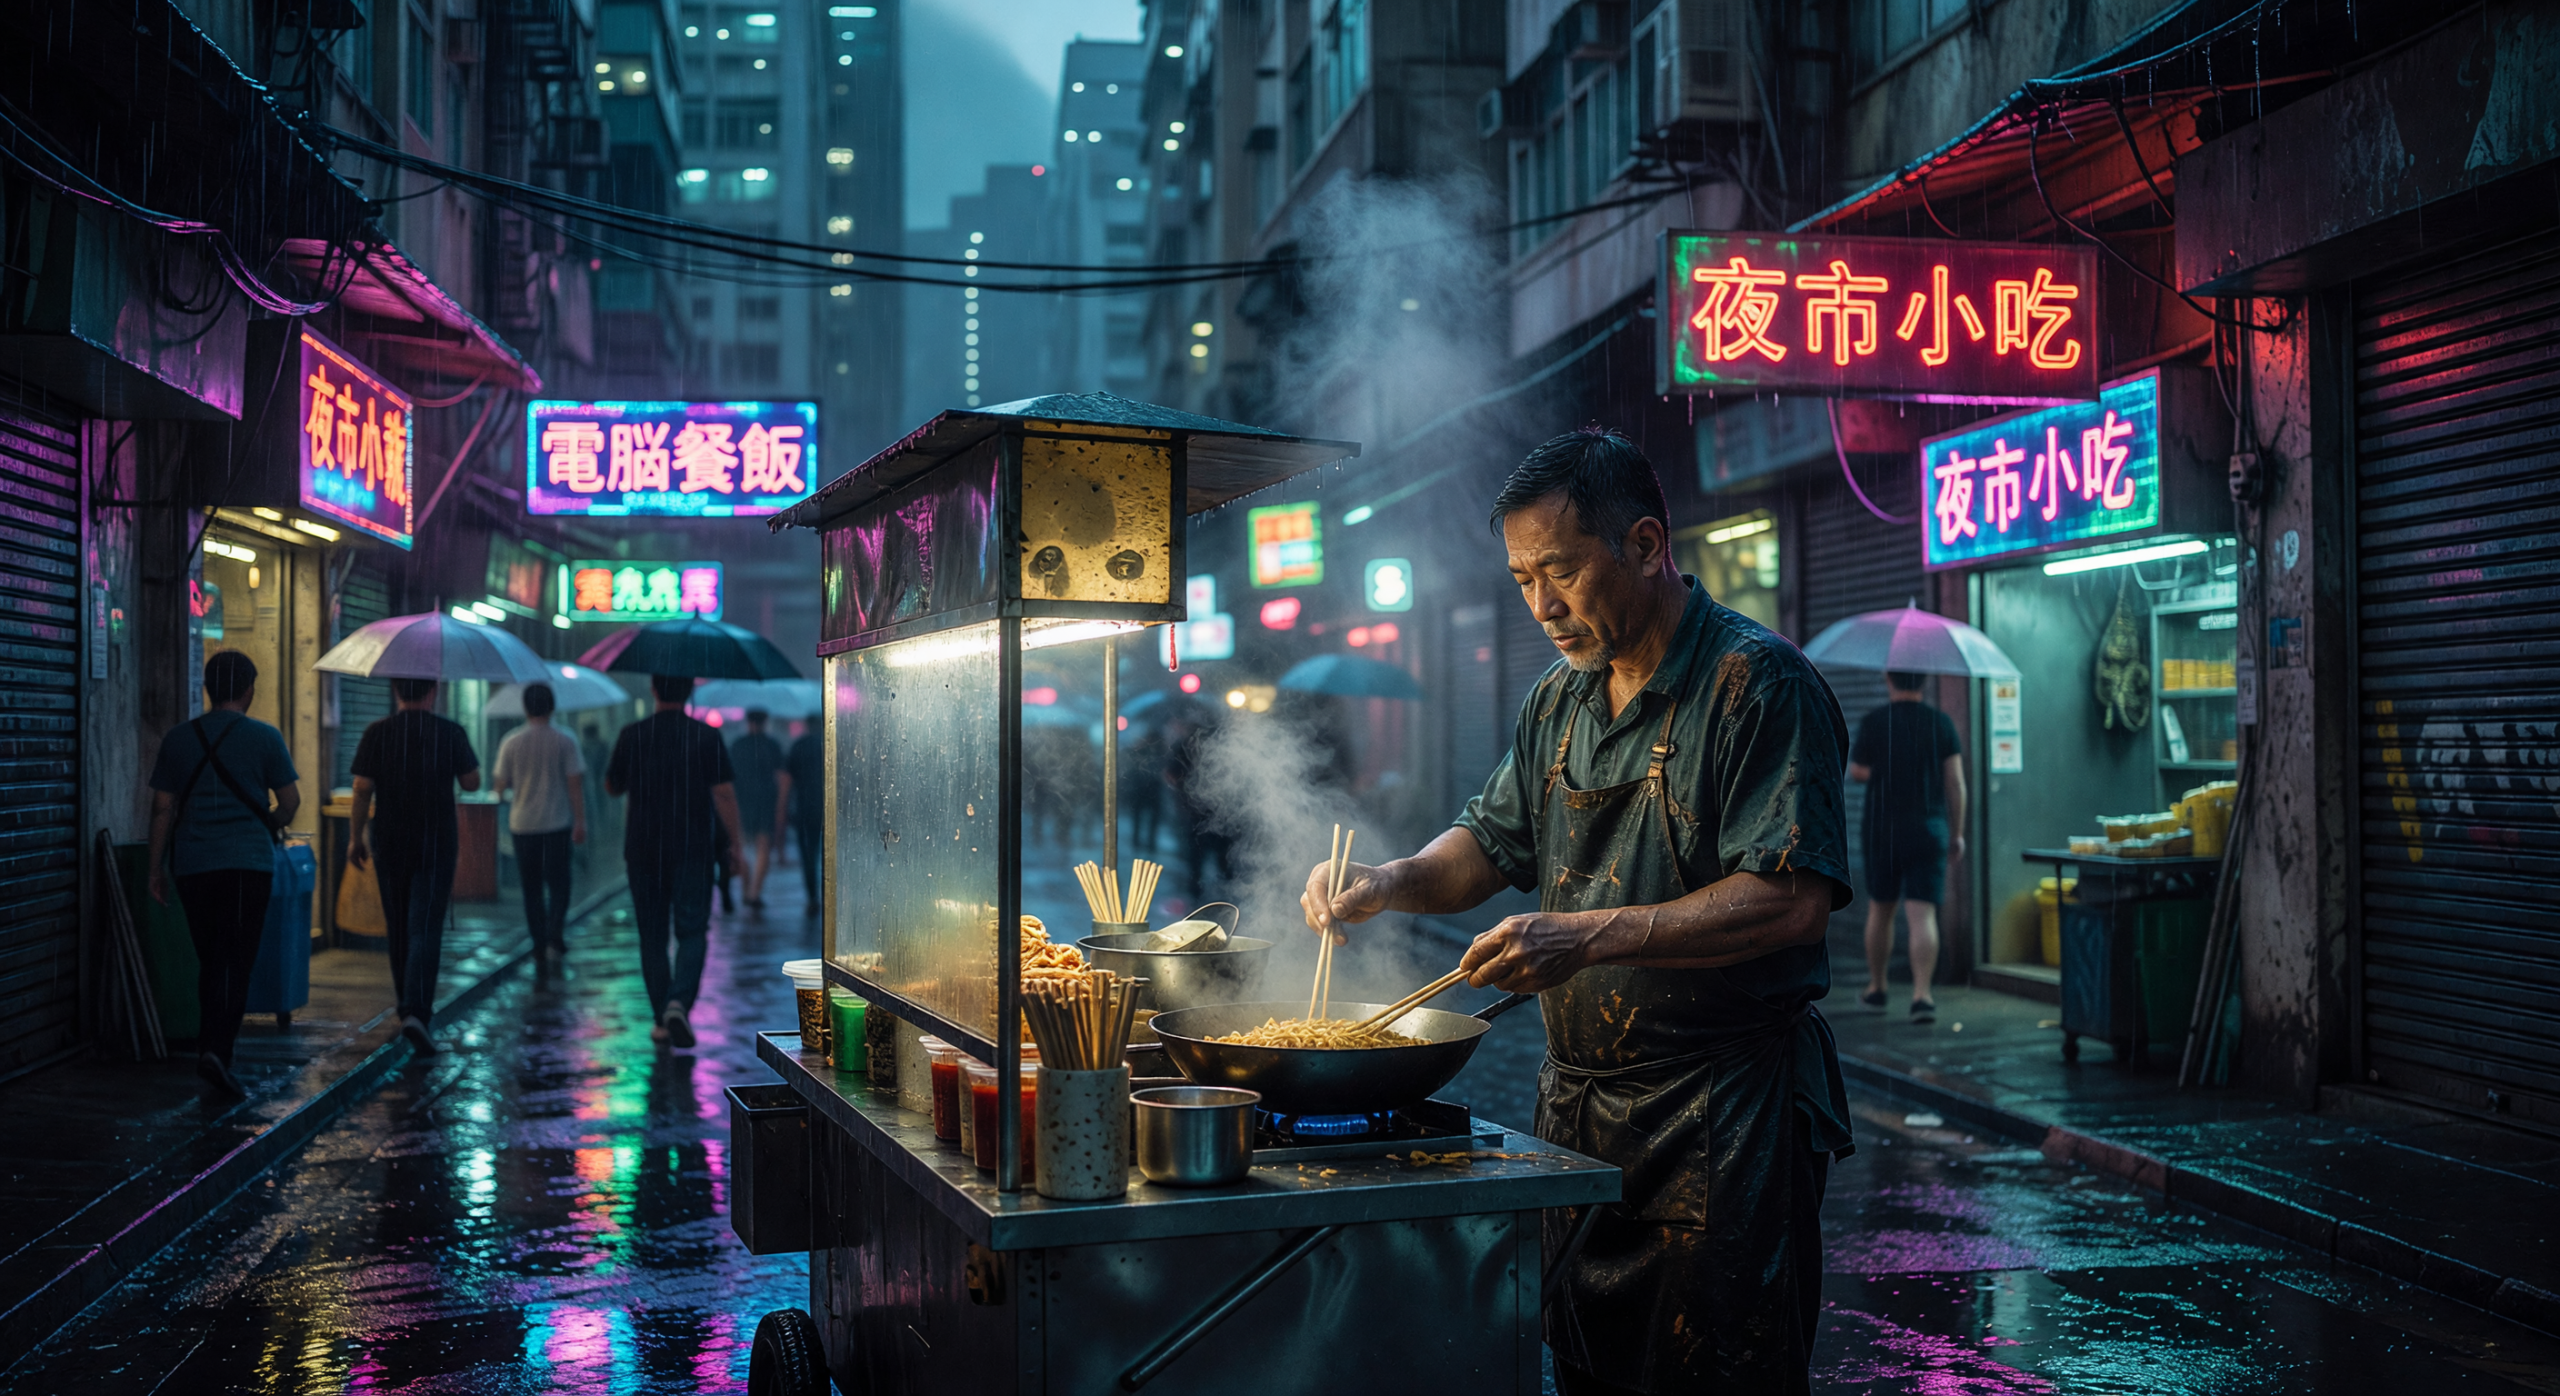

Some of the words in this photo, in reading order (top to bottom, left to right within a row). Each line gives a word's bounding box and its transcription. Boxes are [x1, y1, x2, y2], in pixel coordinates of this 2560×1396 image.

[1692, 257, 2081, 370] 夜市小吃
[1934, 410, 2135, 545] 夜市小吃
